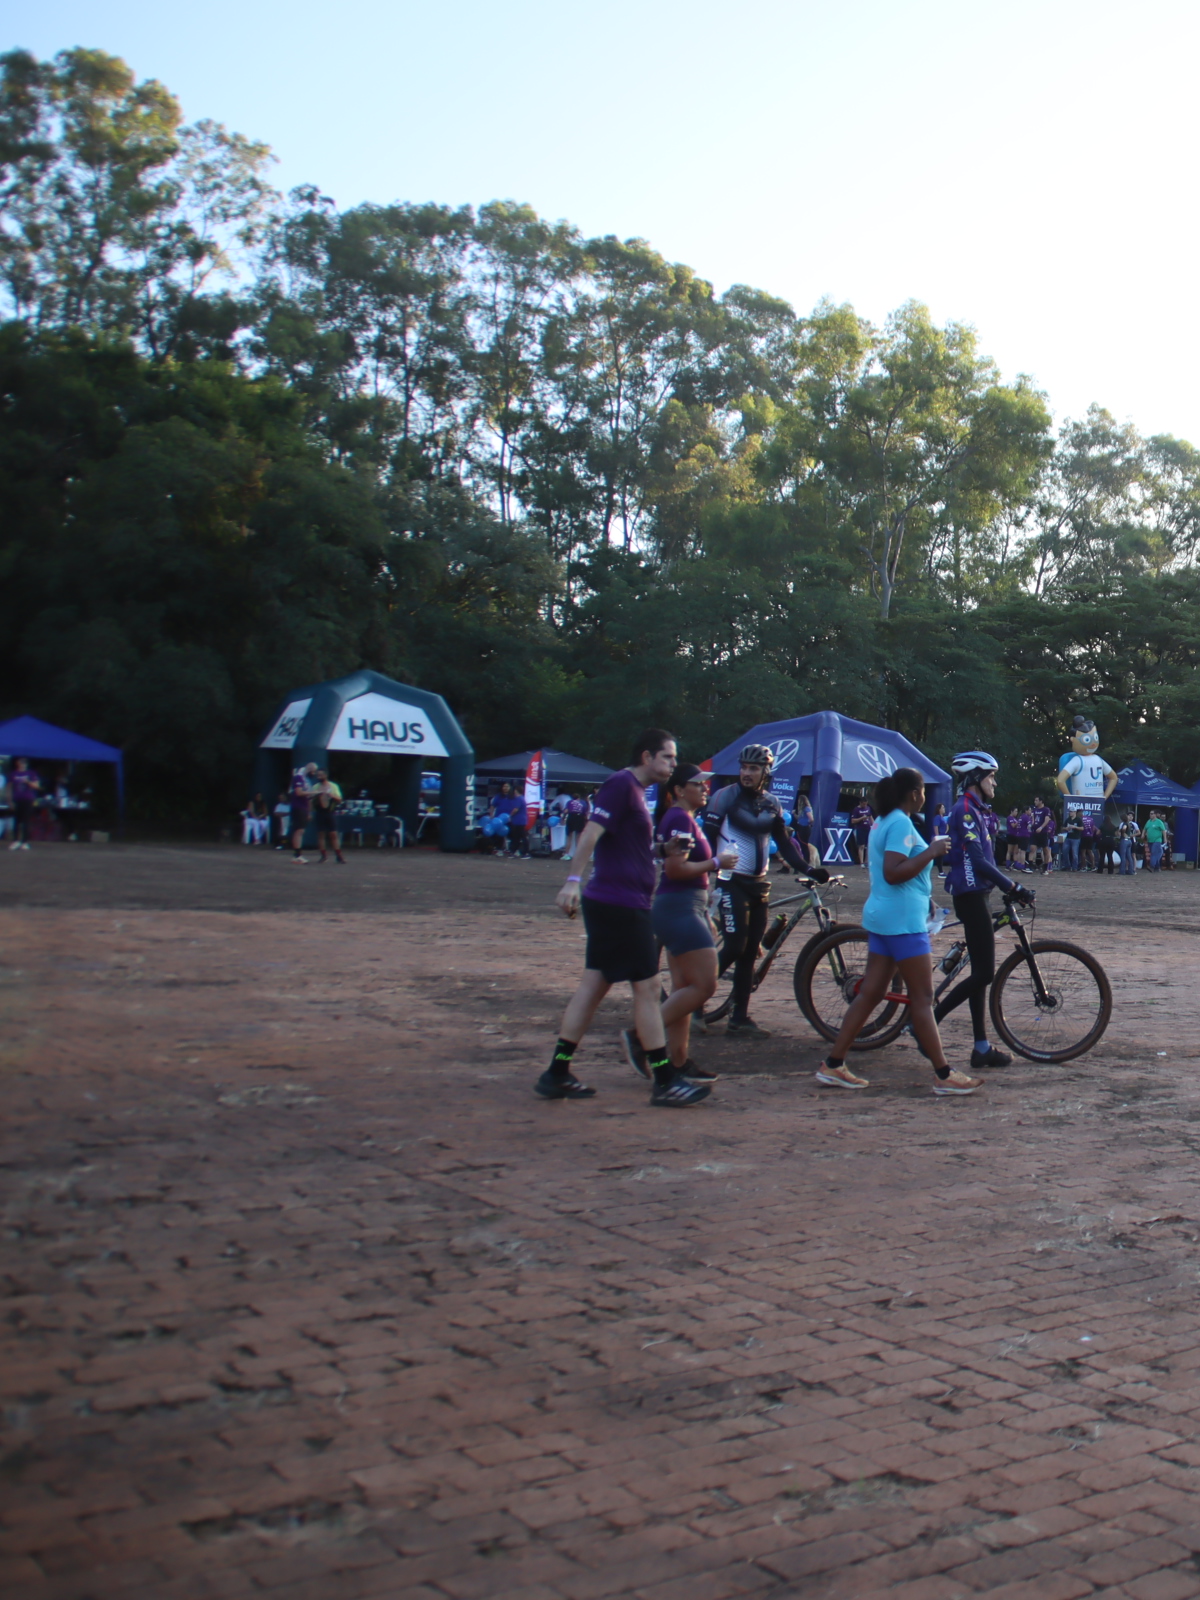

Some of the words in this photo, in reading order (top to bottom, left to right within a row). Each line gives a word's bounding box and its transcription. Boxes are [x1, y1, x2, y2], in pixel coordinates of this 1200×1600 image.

[348, 717, 424, 743] HAUS
[465, 774, 475, 831] HAUS
[1084, 803, 1102, 811] BLITZ
